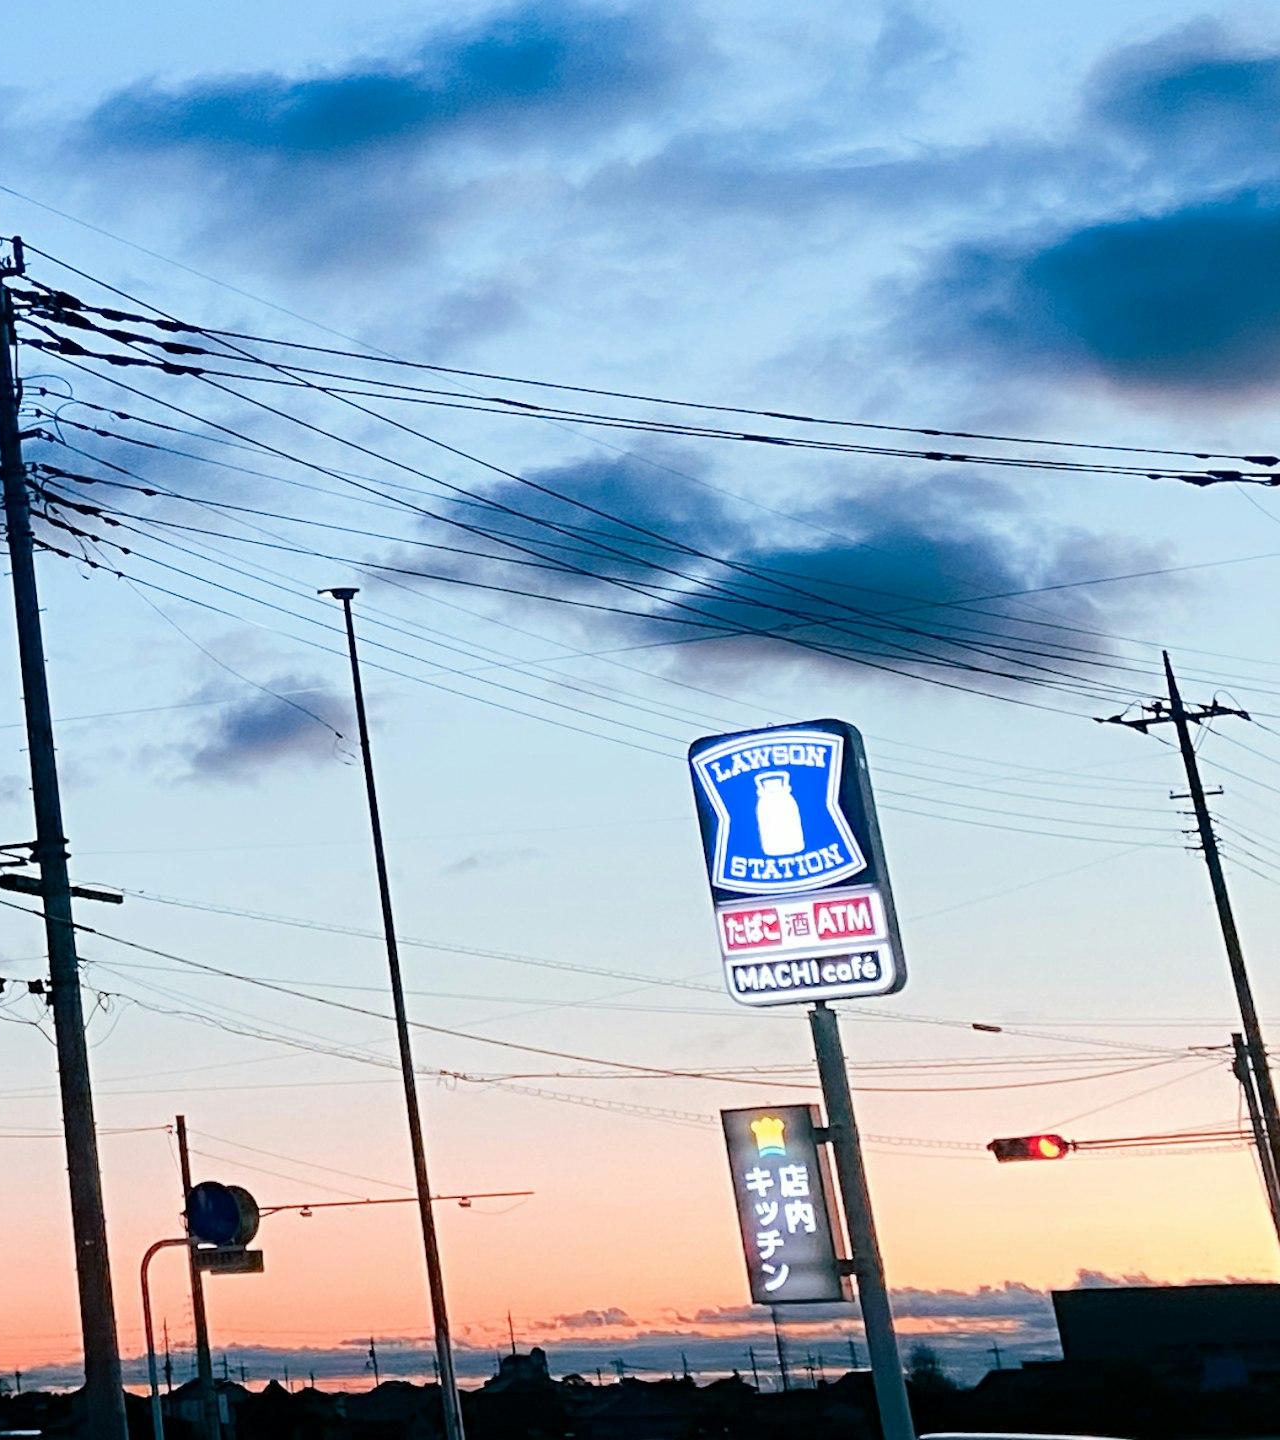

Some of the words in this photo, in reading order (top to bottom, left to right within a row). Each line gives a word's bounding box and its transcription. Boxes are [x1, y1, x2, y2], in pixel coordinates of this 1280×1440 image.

[711, 745, 827, 782] LAWSON
[730, 843, 844, 879] STATION
[726, 912, 781, 945] たばこ
[785, 912, 811, 937] 酒
[817, 903, 872, 935] ATM
[736, 959, 820, 992] MACHI
[821, 955, 877, 983] café
[779, 1164, 817, 1234] 店内
[745, 1166, 790, 1292] キッチン
